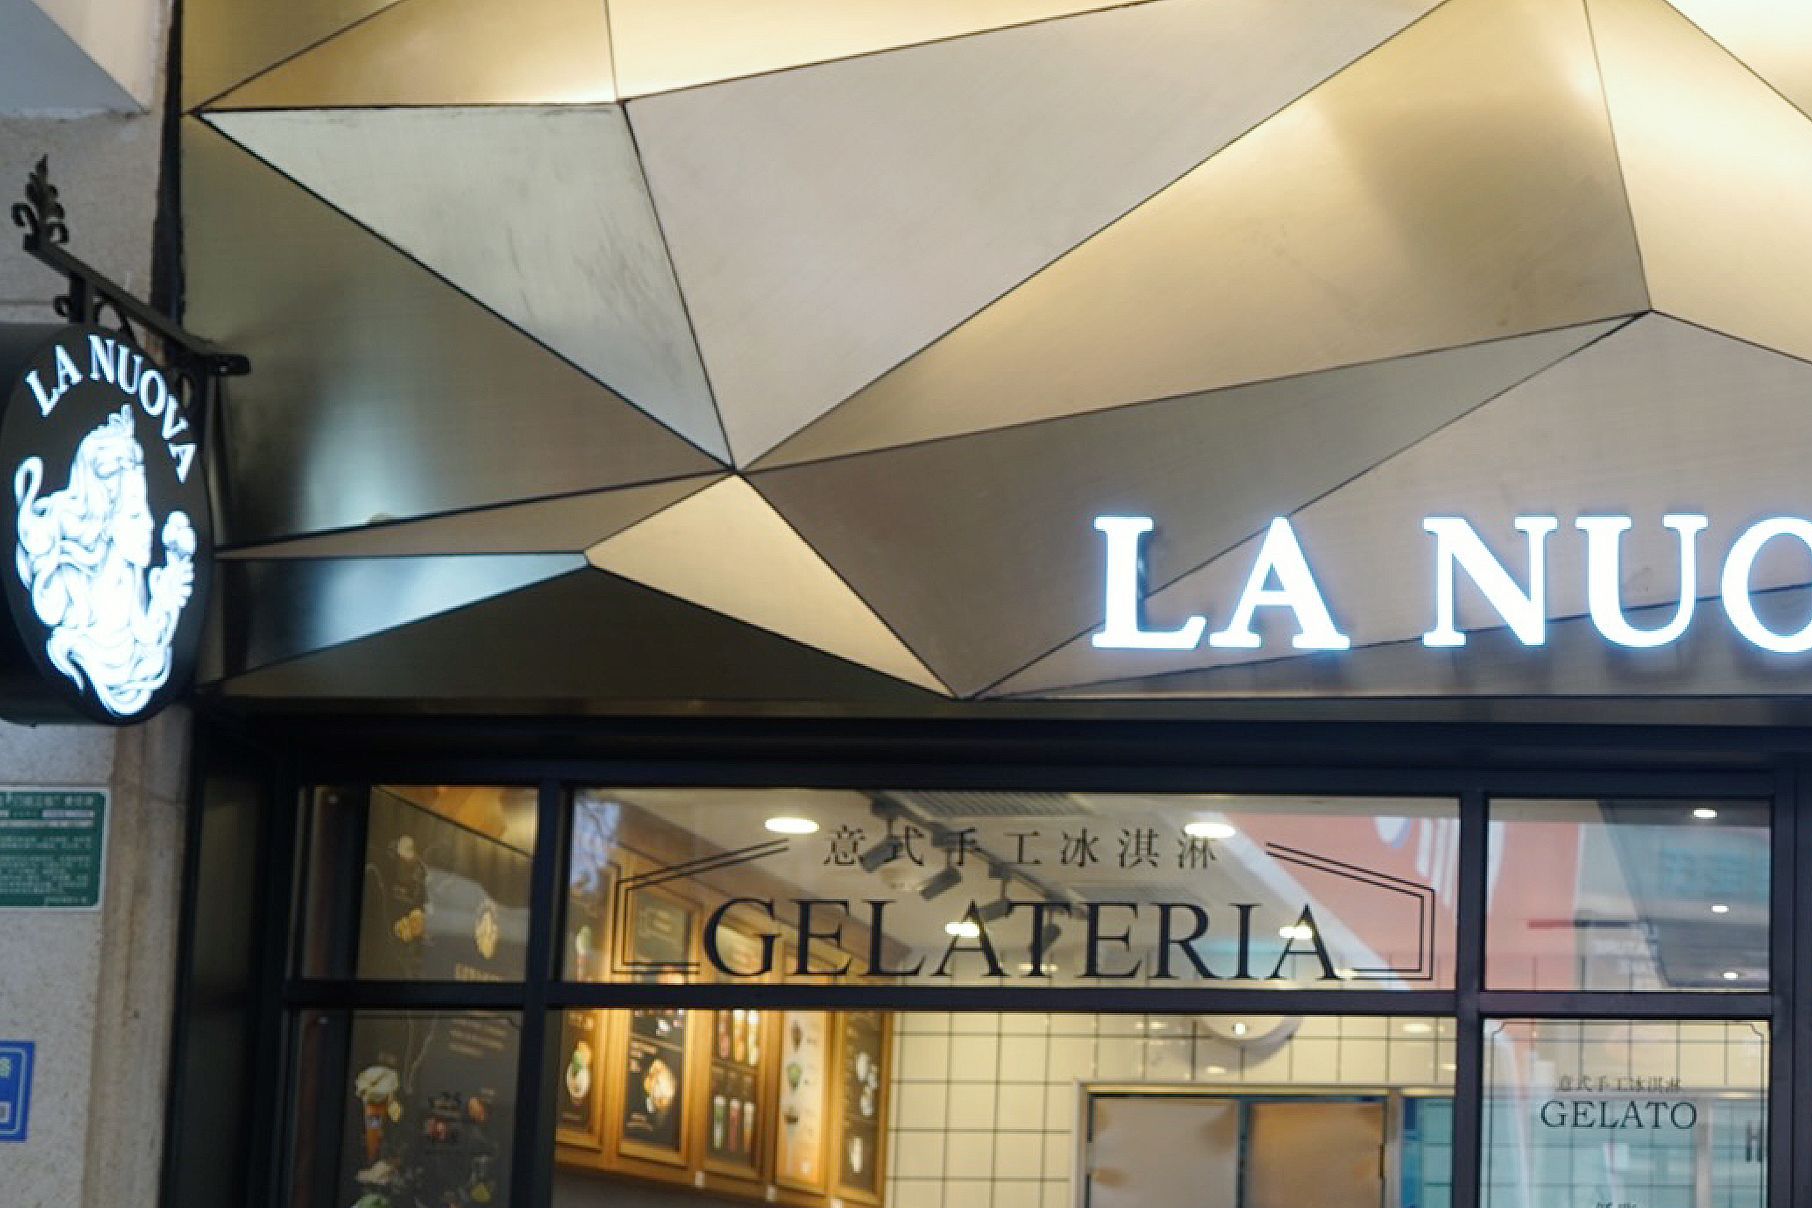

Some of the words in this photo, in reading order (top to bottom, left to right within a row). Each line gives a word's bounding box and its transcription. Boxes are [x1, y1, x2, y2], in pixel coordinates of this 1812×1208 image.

[25, 345, 84, 418] LA
[88, 334, 197, 484] NUOVA
[1091, 515, 1352, 650] LA
[823, 824, 1218, 870] 意式手工冰淇淋
[704, 898, 1343, 980] GELATERIA
[1540, 1100, 1698, 1130] GELATO
